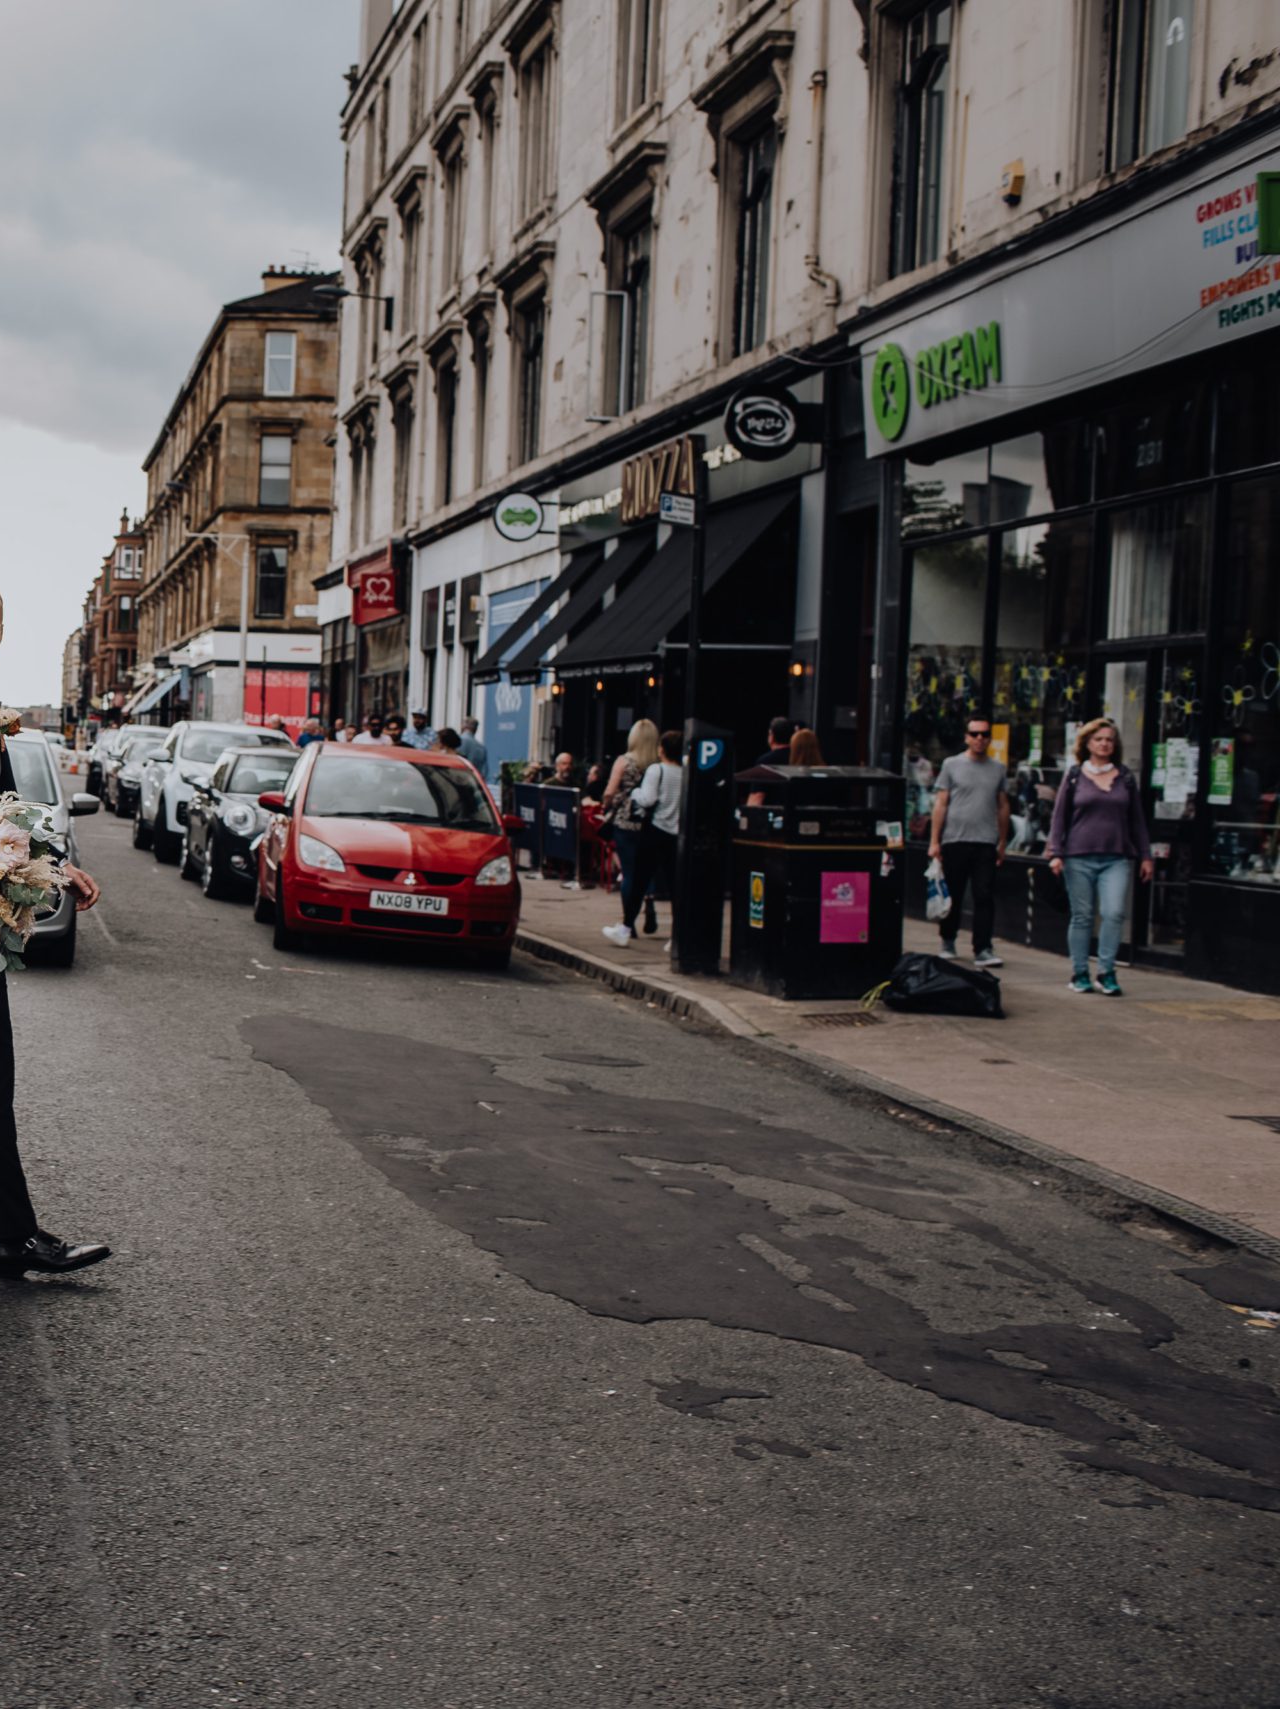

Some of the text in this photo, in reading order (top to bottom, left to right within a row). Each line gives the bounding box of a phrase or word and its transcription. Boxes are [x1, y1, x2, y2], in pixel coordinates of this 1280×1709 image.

[1196, 187, 1242, 223] GROWS
[1202, 220, 1235, 249] FILLS
[1200, 264, 1270, 309] EMPOWERS
[1218, 295, 1266, 328] FIGHTS
[915, 319, 1001, 409] OXFAM
[621, 433, 696, 524] MOZZA
[701, 740, 718, 765] P
[376, 893, 442, 911] NX08 YPU
